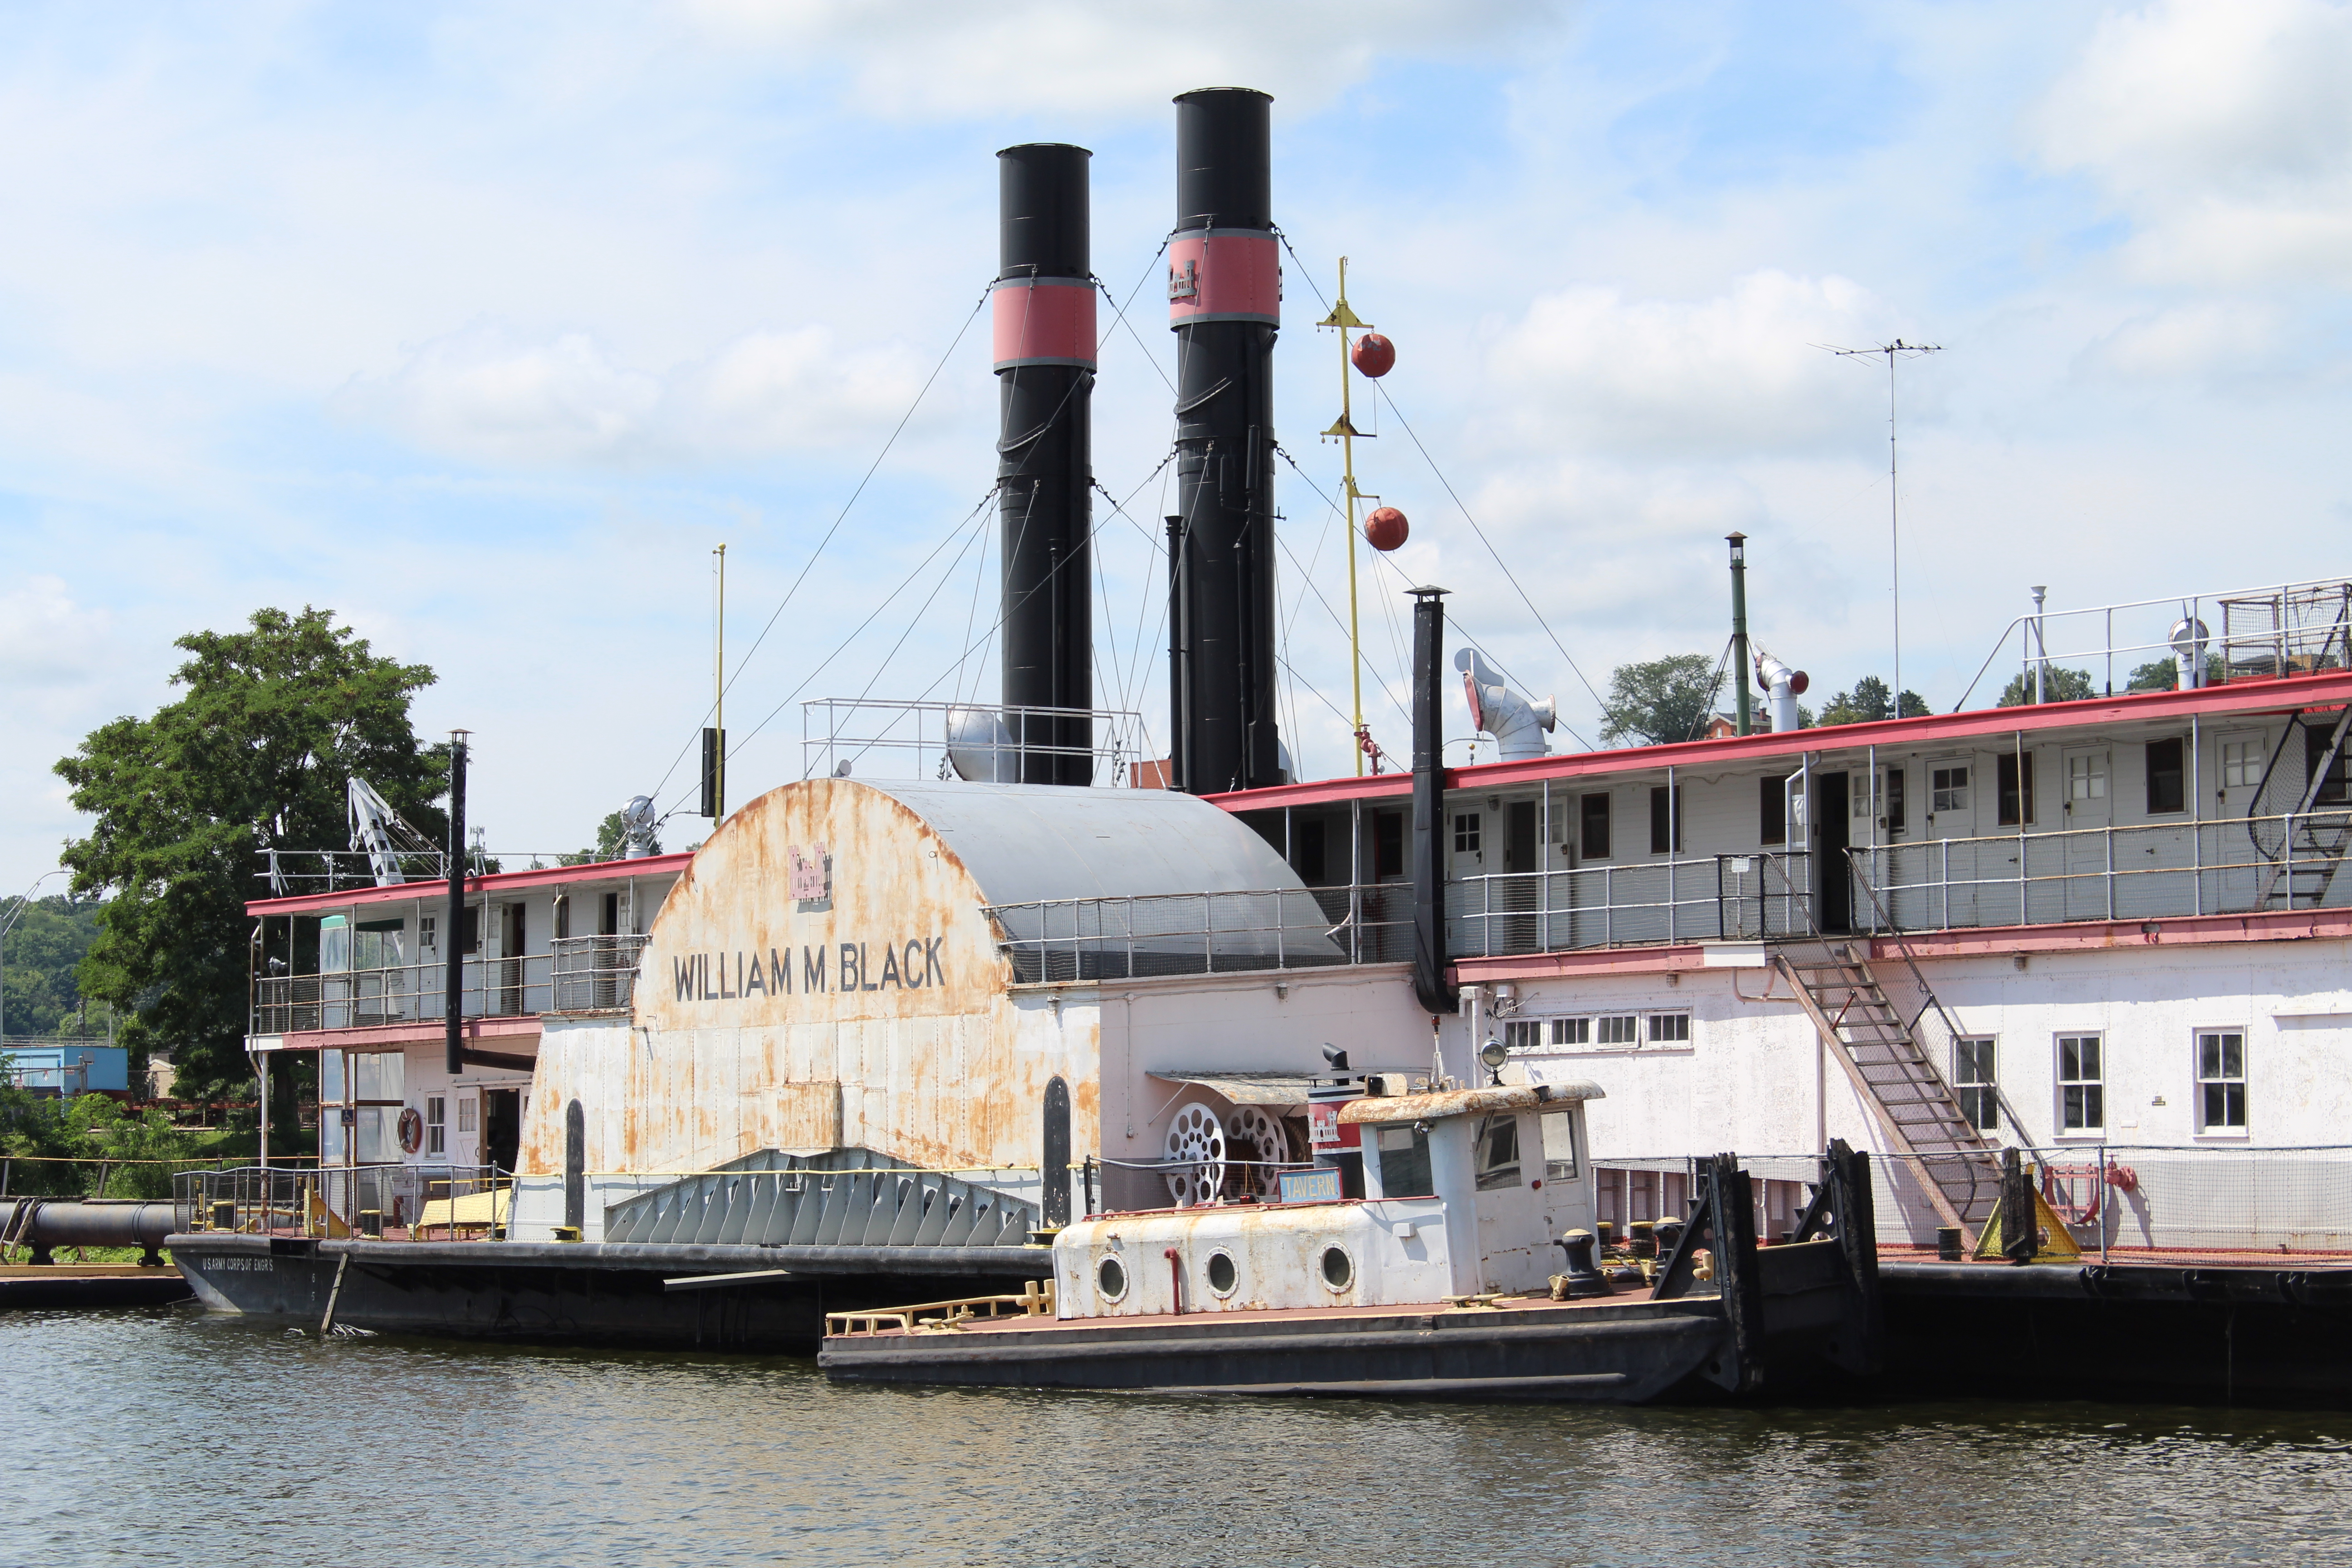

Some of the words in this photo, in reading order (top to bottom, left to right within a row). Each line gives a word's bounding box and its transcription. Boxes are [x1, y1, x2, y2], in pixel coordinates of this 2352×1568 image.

[673, 947, 792, 1002] WILLIAM
[804, 945, 835, 994] M.
[840, 936, 946, 992] BLACK
[1284, 1175, 1336, 1198] TAVERN
[227, 1258, 245, 1271] CORPS
[245, 1258, 252, 1270] OF
[312, 1273, 315, 1283] 6
[311, 1292, 315, 1301] 5
